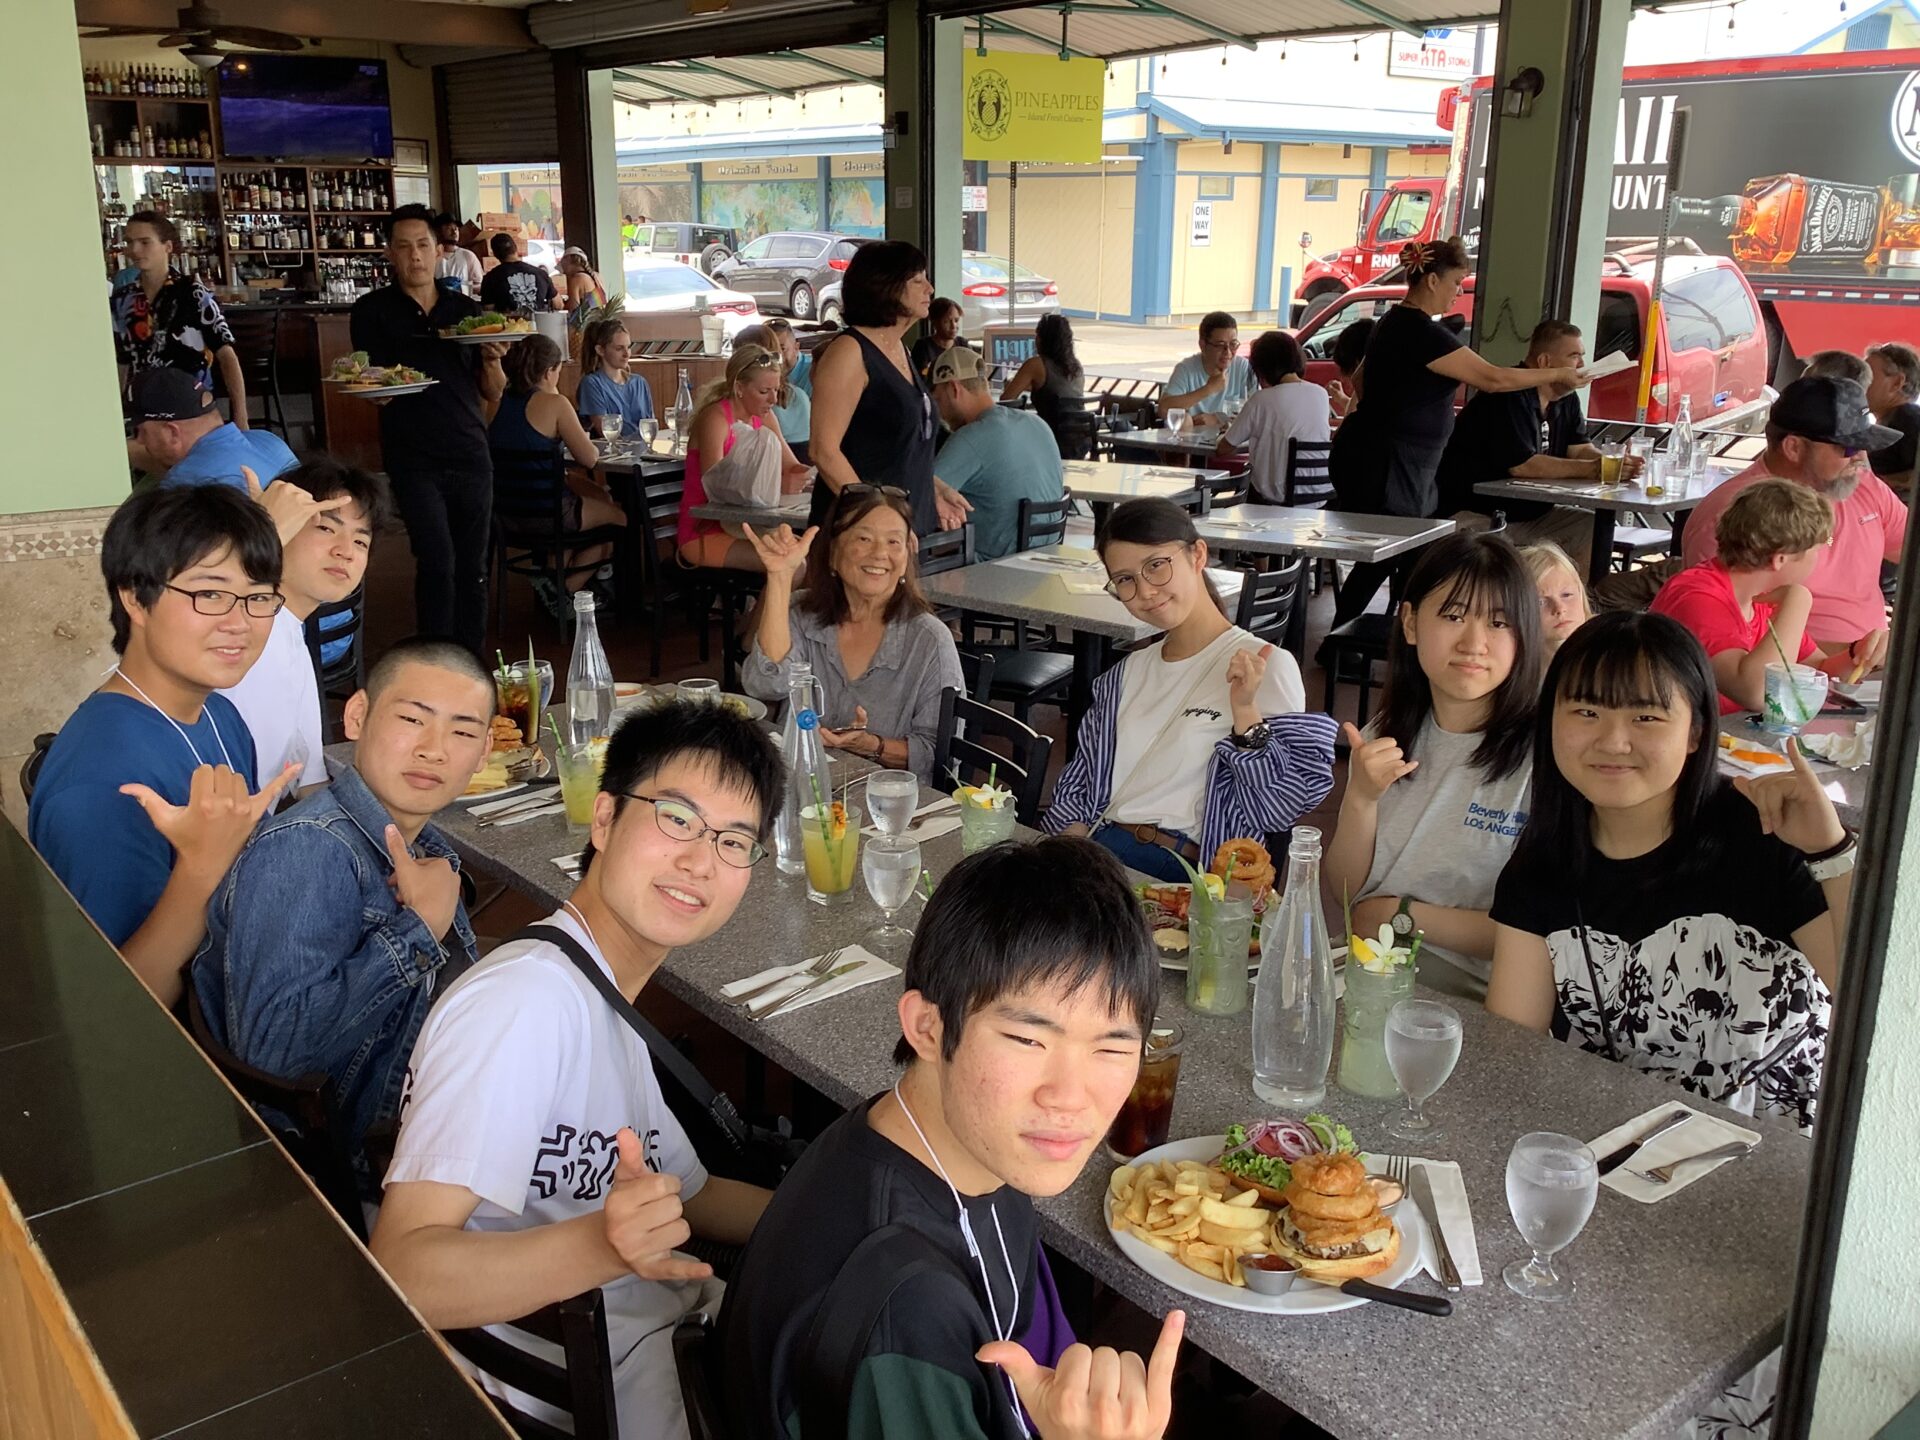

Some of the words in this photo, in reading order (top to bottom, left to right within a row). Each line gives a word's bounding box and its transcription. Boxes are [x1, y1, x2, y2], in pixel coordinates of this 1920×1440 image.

[1015, 91, 1099, 111] PINEAPPLES
[1195, 206, 1210, 216] ONE
[1194, 220, 1209, 230] WAY
[1463, 234, 1480, 246] MAK
[1808, 225, 1823, 253] JACK
[1468, 802, 1510, 823] Beverly
[1464, 816, 1485, 830] LOS
